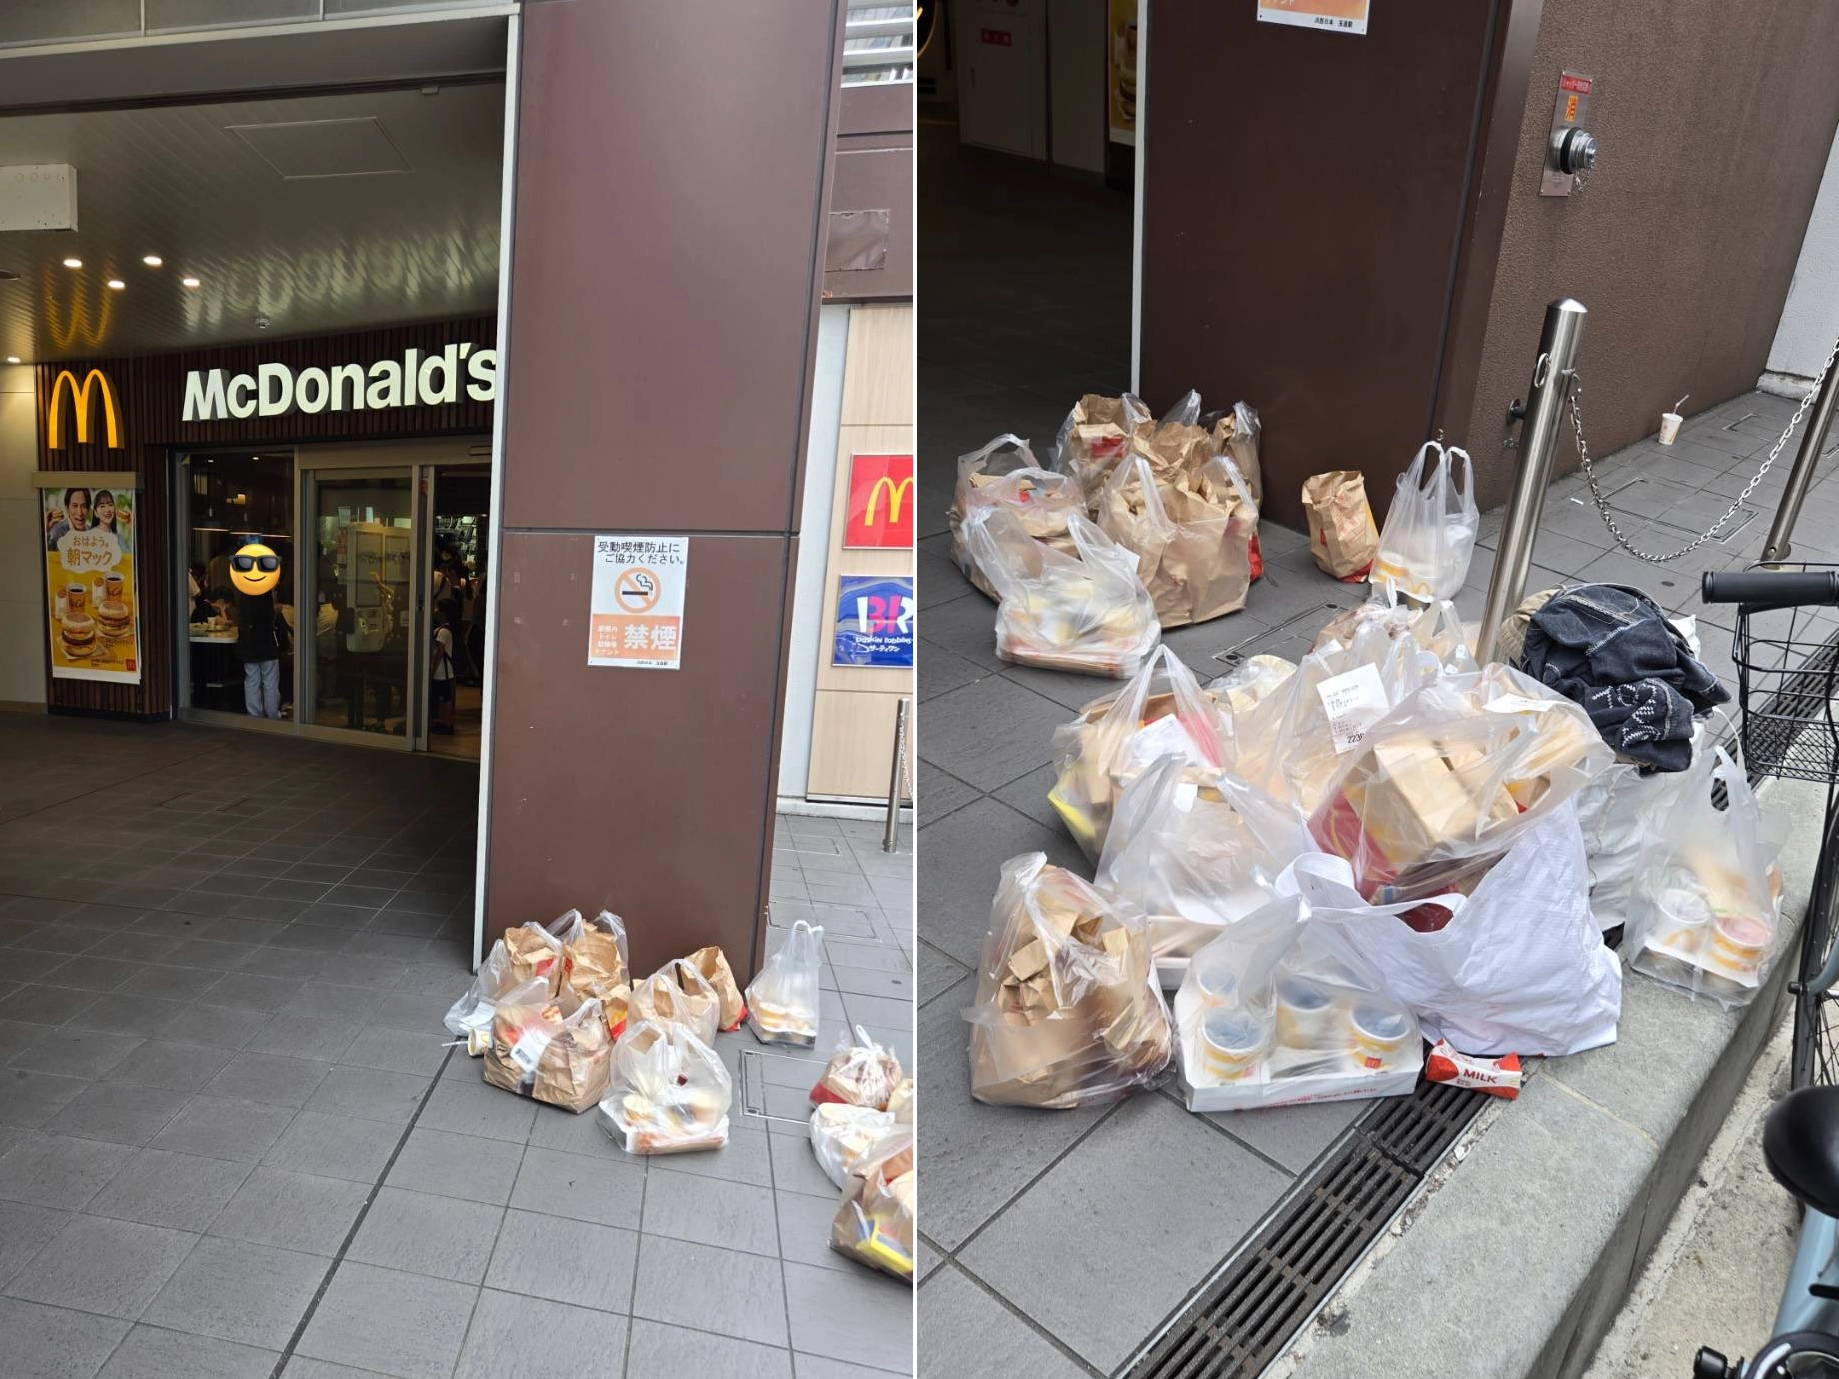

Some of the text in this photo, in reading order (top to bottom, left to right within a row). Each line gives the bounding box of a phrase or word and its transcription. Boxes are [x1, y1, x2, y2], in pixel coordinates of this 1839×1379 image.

[182, 342, 497, 422] McDonald's
[72, 535, 109, 548] おはよう。
[597, 541, 680, 553] 受動喫煙防止に
[66, 547, 113, 566] 朝マック
[605, 553, 684, 564] ご協力ください。
[624, 624, 677, 650] 禁煙
[1463, 1068, 1498, 1084] MILK
